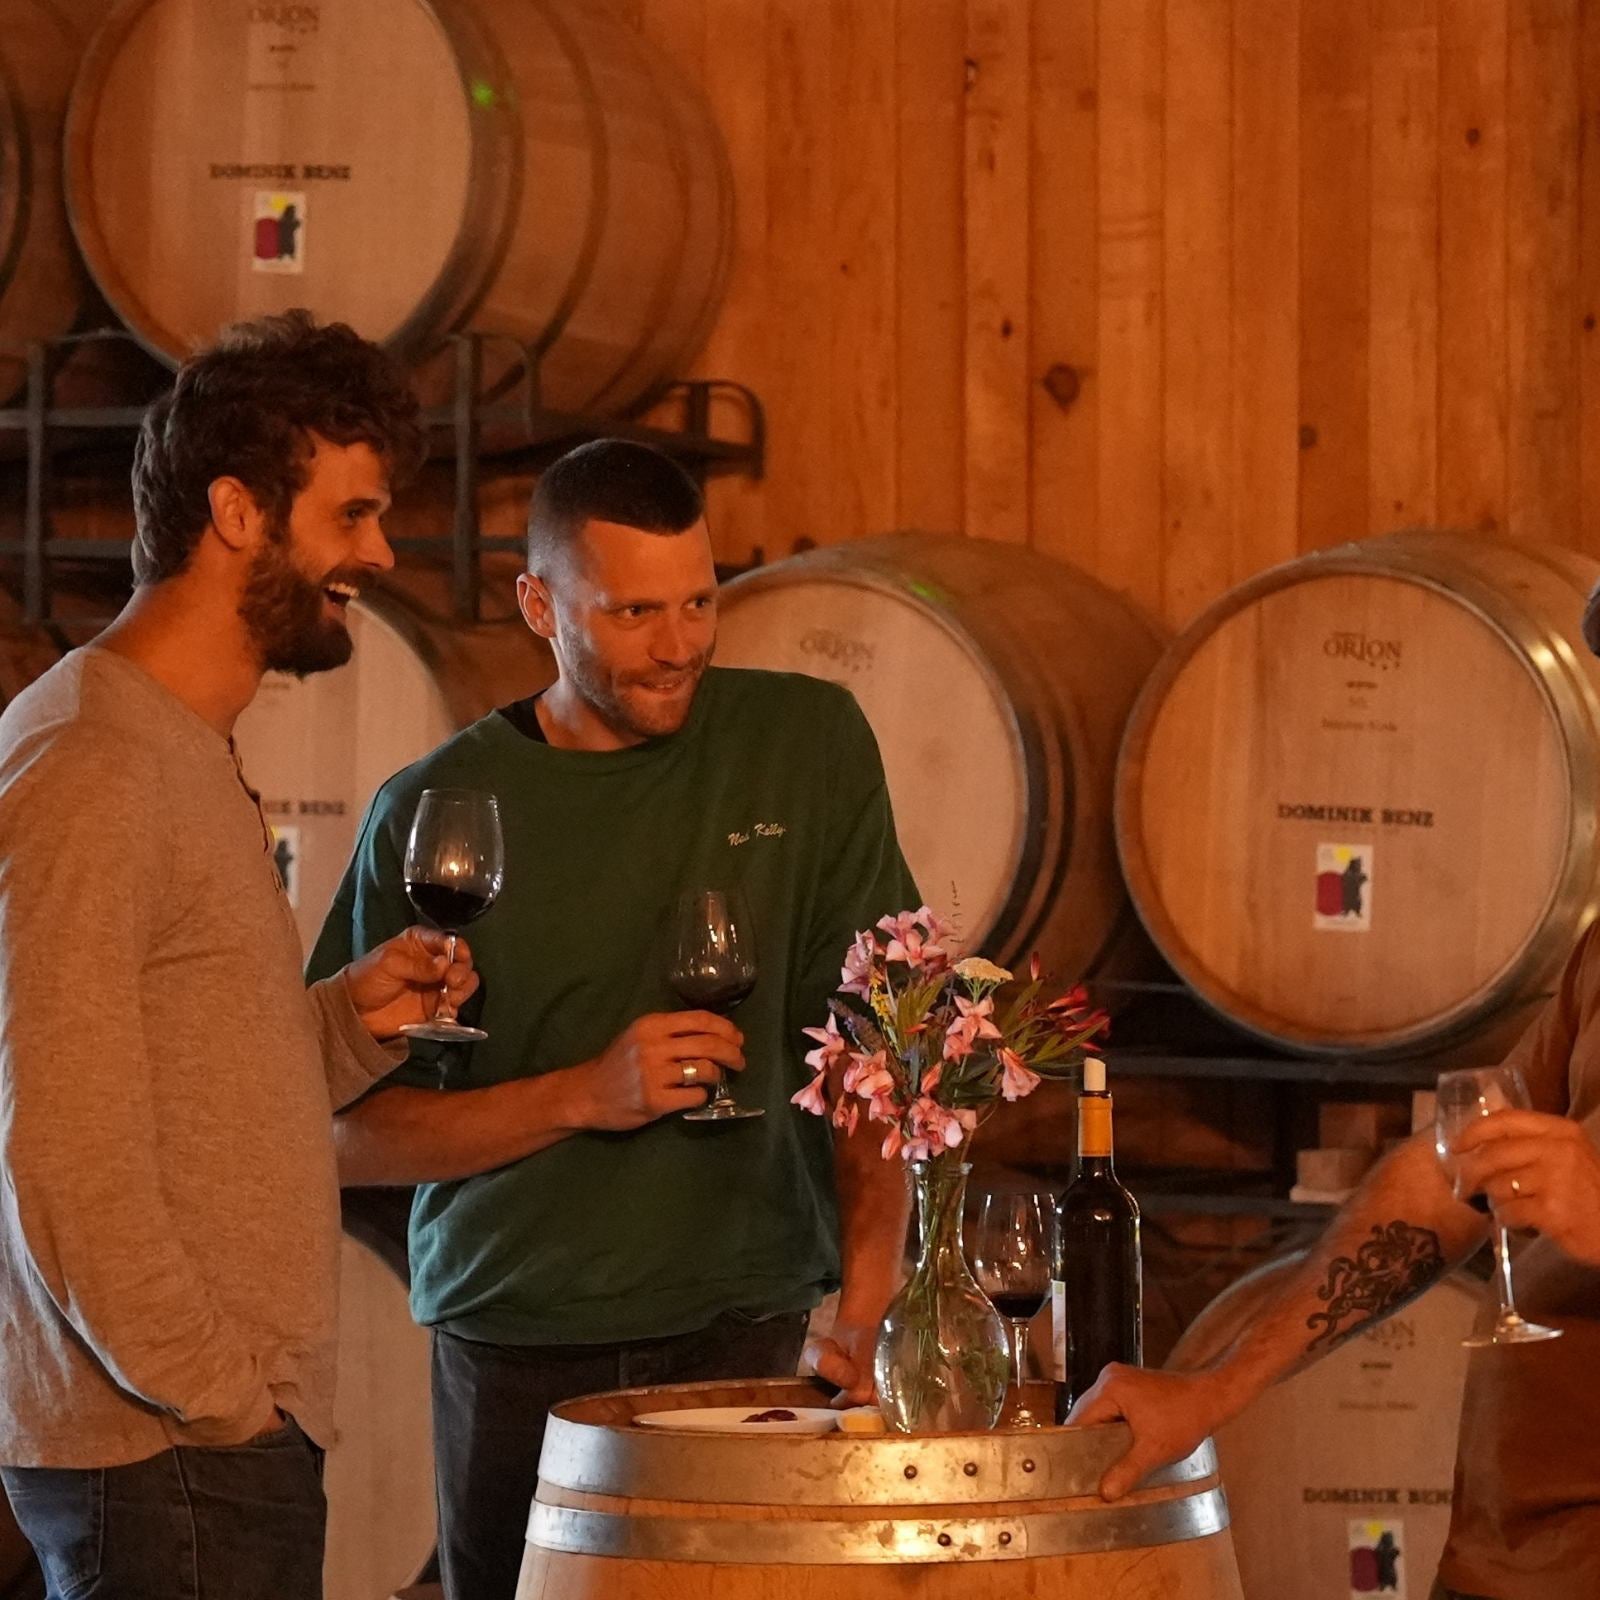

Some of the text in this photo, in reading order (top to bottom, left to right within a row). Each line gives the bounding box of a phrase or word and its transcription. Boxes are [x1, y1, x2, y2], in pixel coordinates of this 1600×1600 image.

[1322, 631, 1402, 661] ORION
[1277, 804, 1434, 828] DOMINIK BENZ
[1303, 1487, 1453, 1504] DOMINIK BEN
